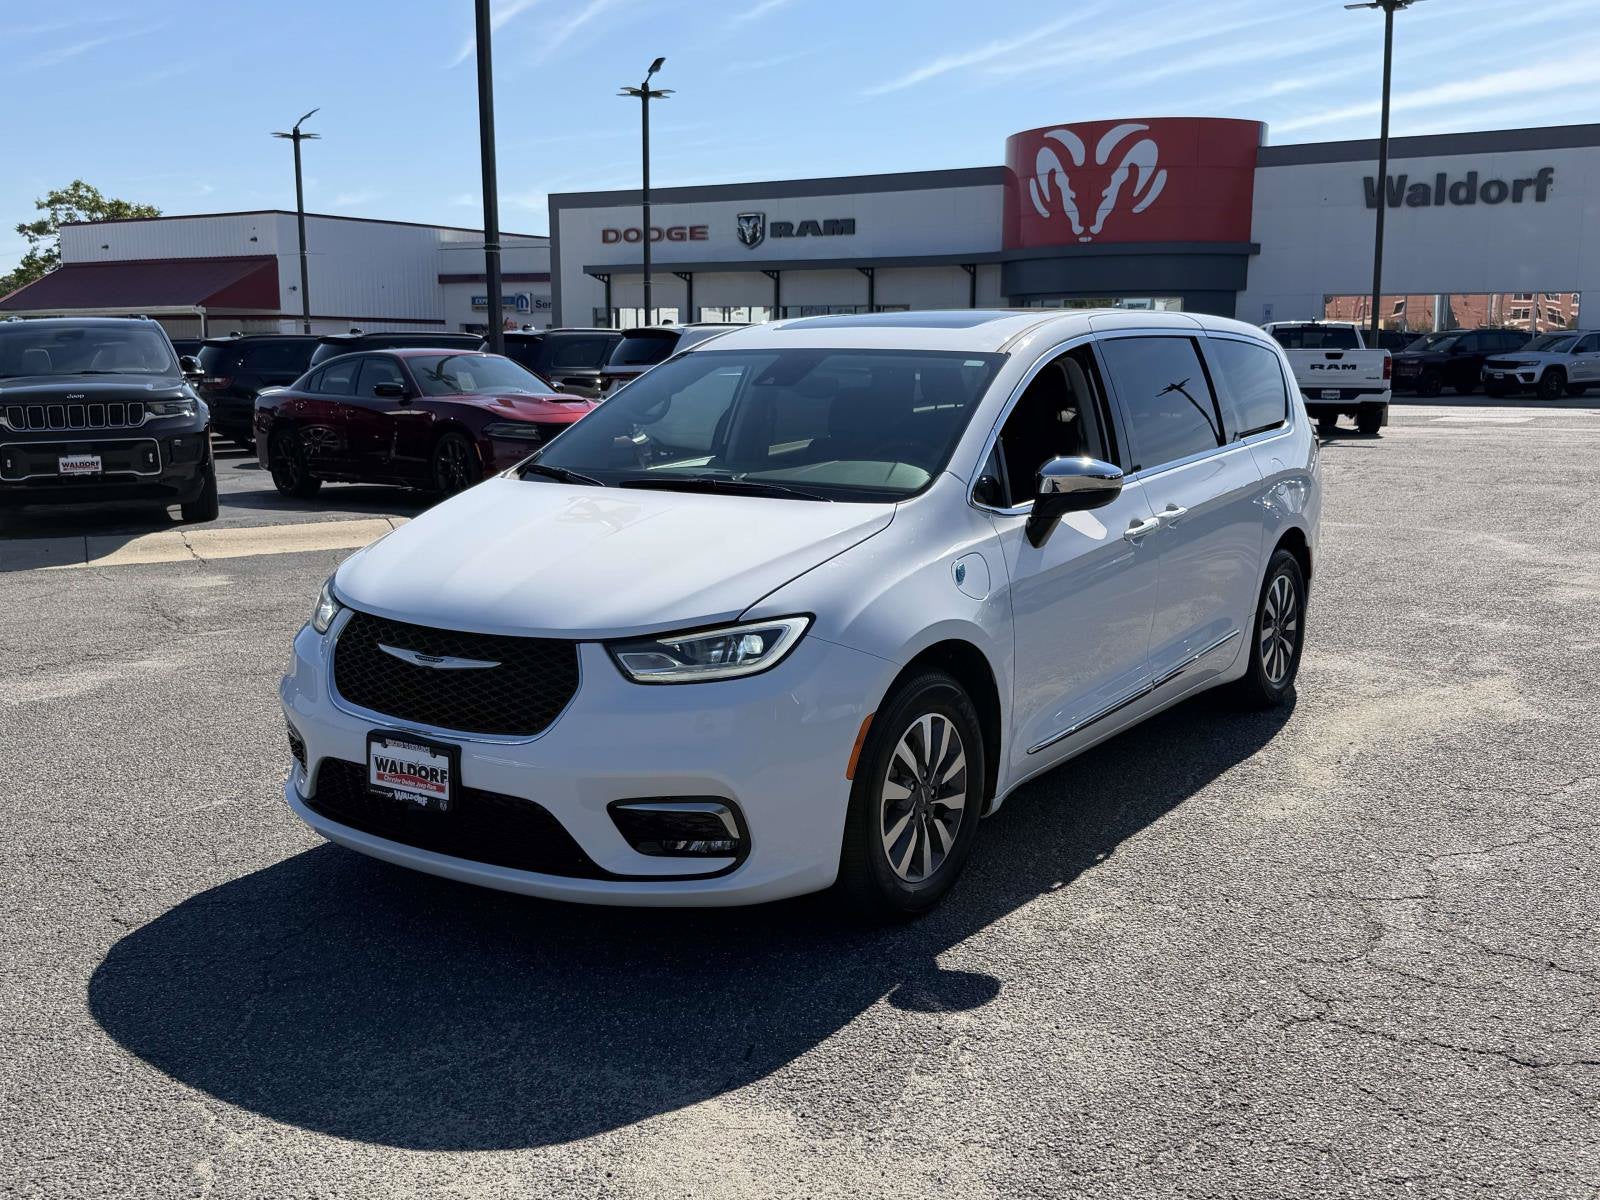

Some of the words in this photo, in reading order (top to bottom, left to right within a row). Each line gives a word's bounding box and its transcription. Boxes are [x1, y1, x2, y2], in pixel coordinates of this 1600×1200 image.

[1363, 167, 1555, 209] Waldorf
[601, 225, 710, 244] DODGE
[770, 218, 856, 238] RAM
[375, 756, 447, 783] WALDORF
